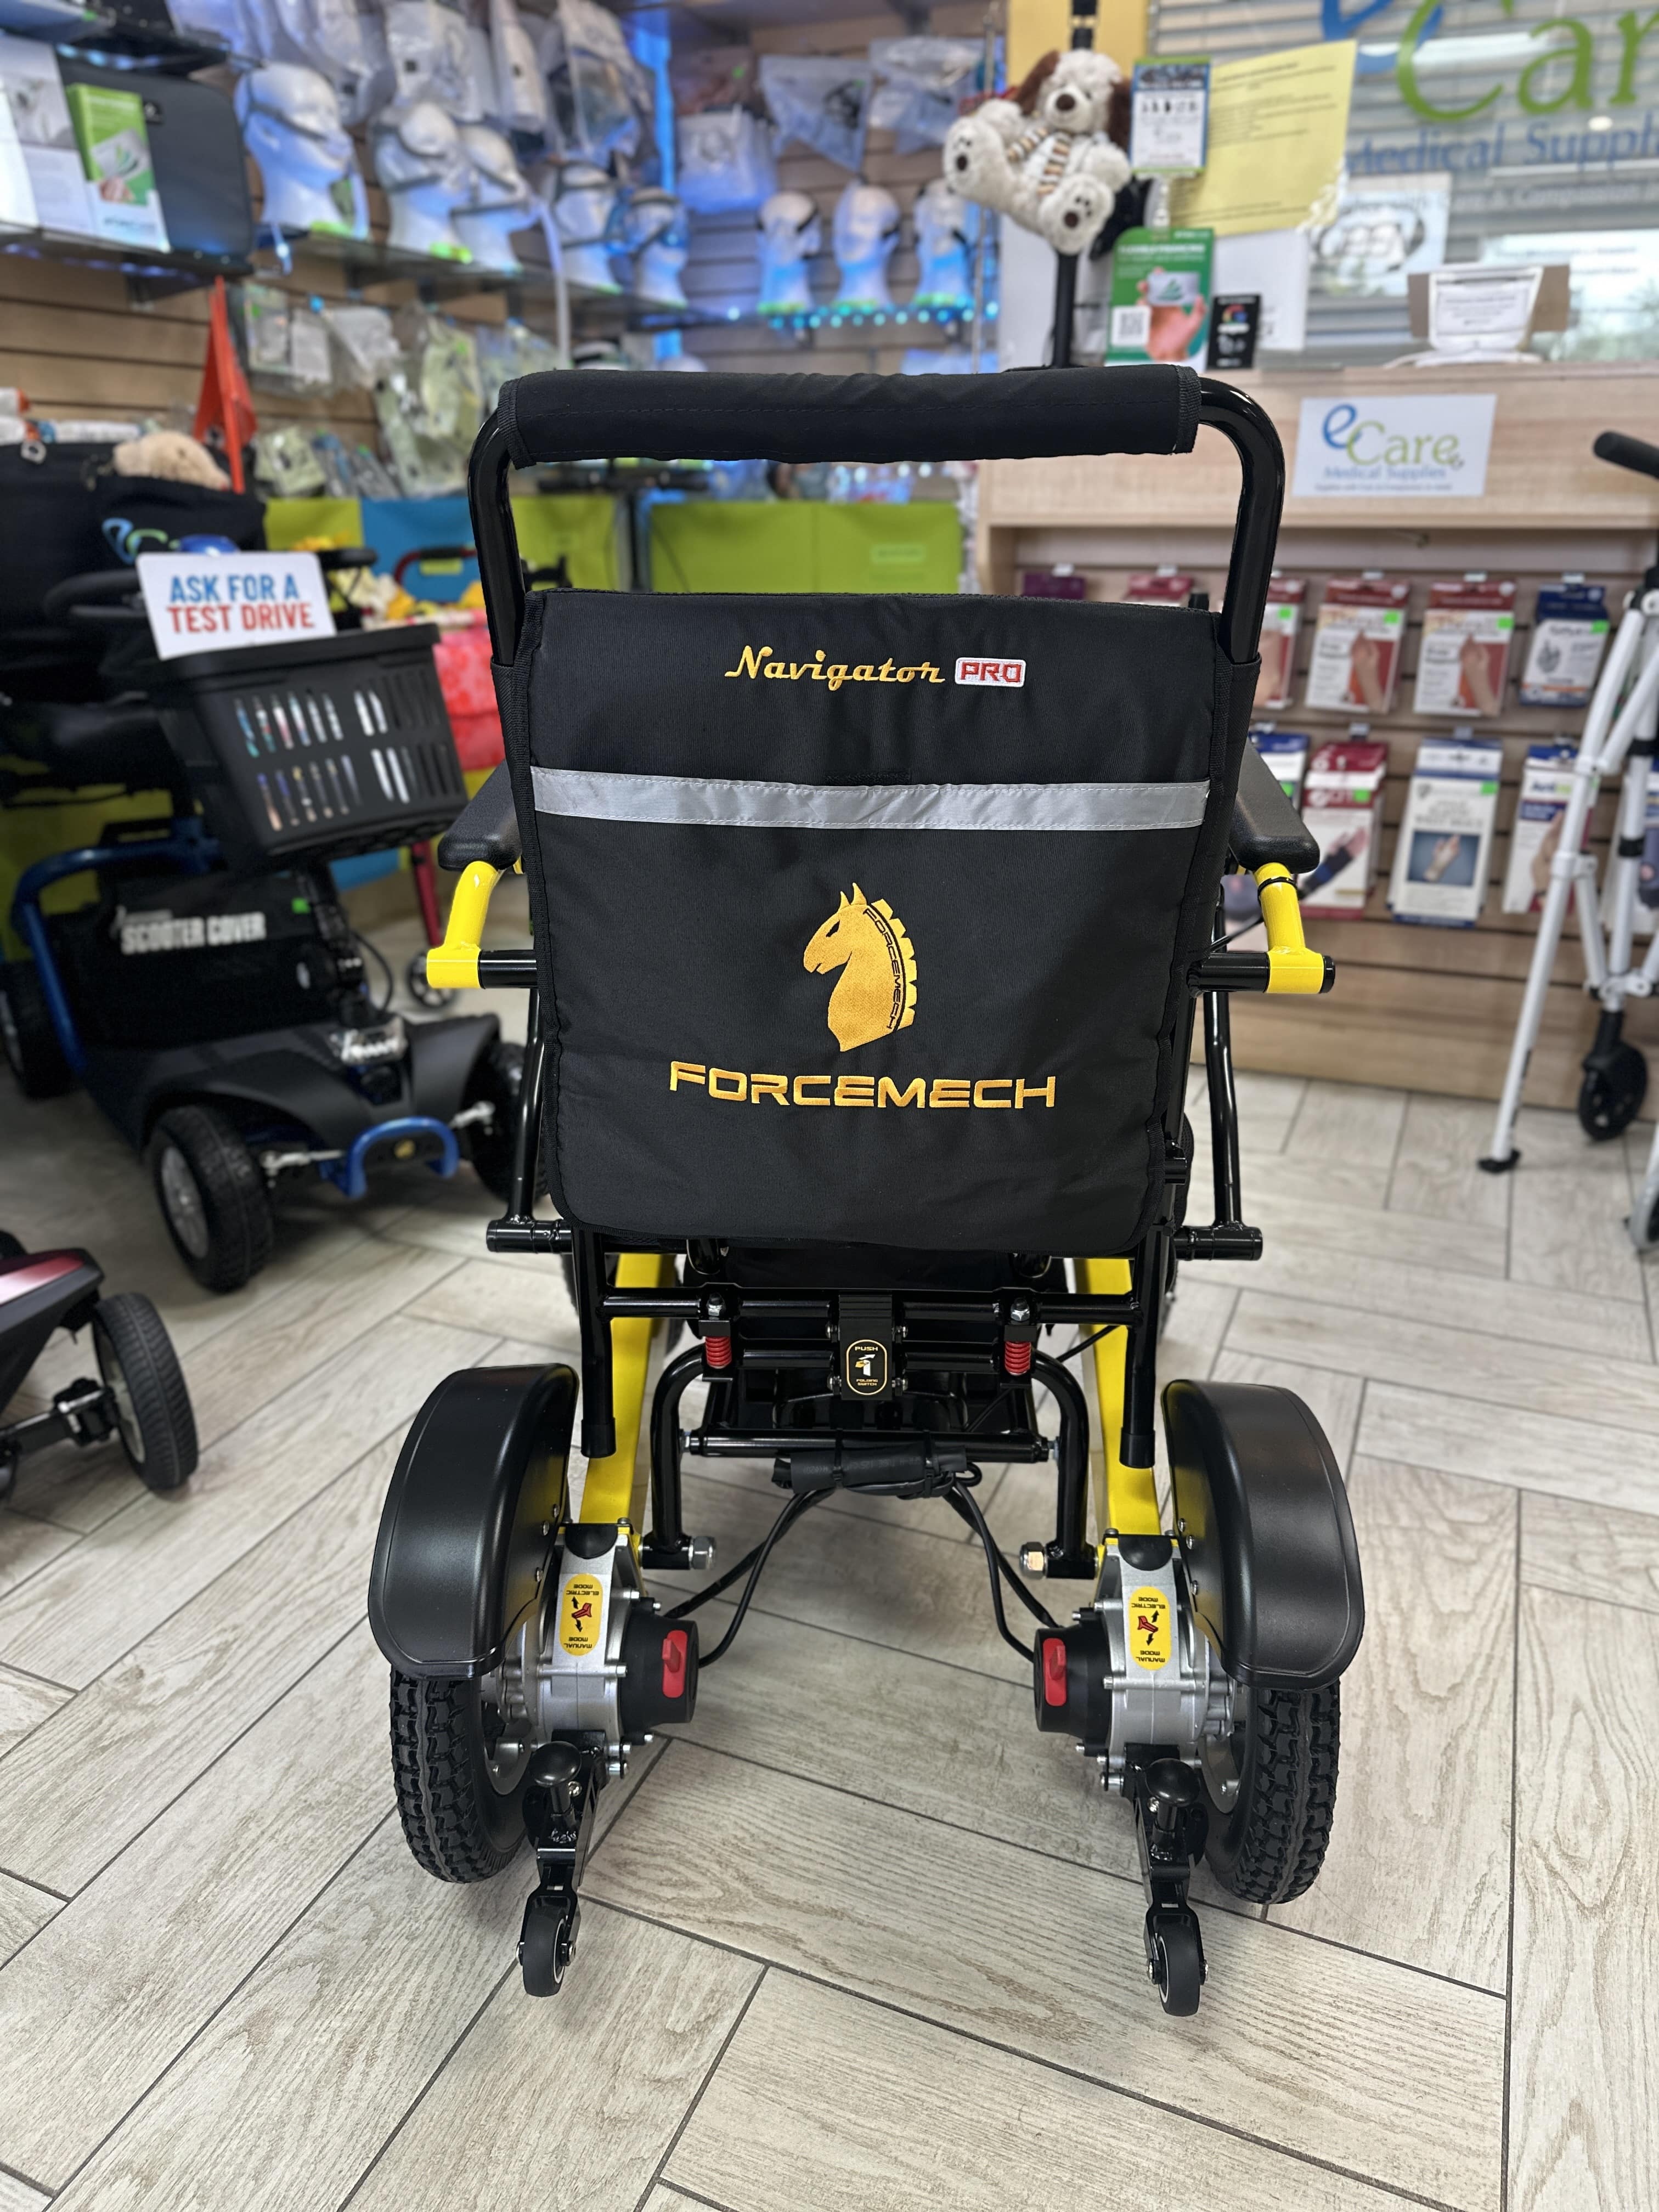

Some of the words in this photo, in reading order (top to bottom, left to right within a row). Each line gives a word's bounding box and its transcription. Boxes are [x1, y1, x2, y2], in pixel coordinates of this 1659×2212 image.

[1322, 403, 1459, 466] eCare
[171, 575, 219, 602] ASK
[229, 574, 274, 601] FOR
[285, 573, 298, 600] A
[167, 605, 232, 633] TEST
[240, 603, 315, 631] DRIVE
[725, 645, 945, 691] Navigator
[961, 662, 1021, 684] PRO
[670, 1060, 1056, 1109] FORCEMECH
